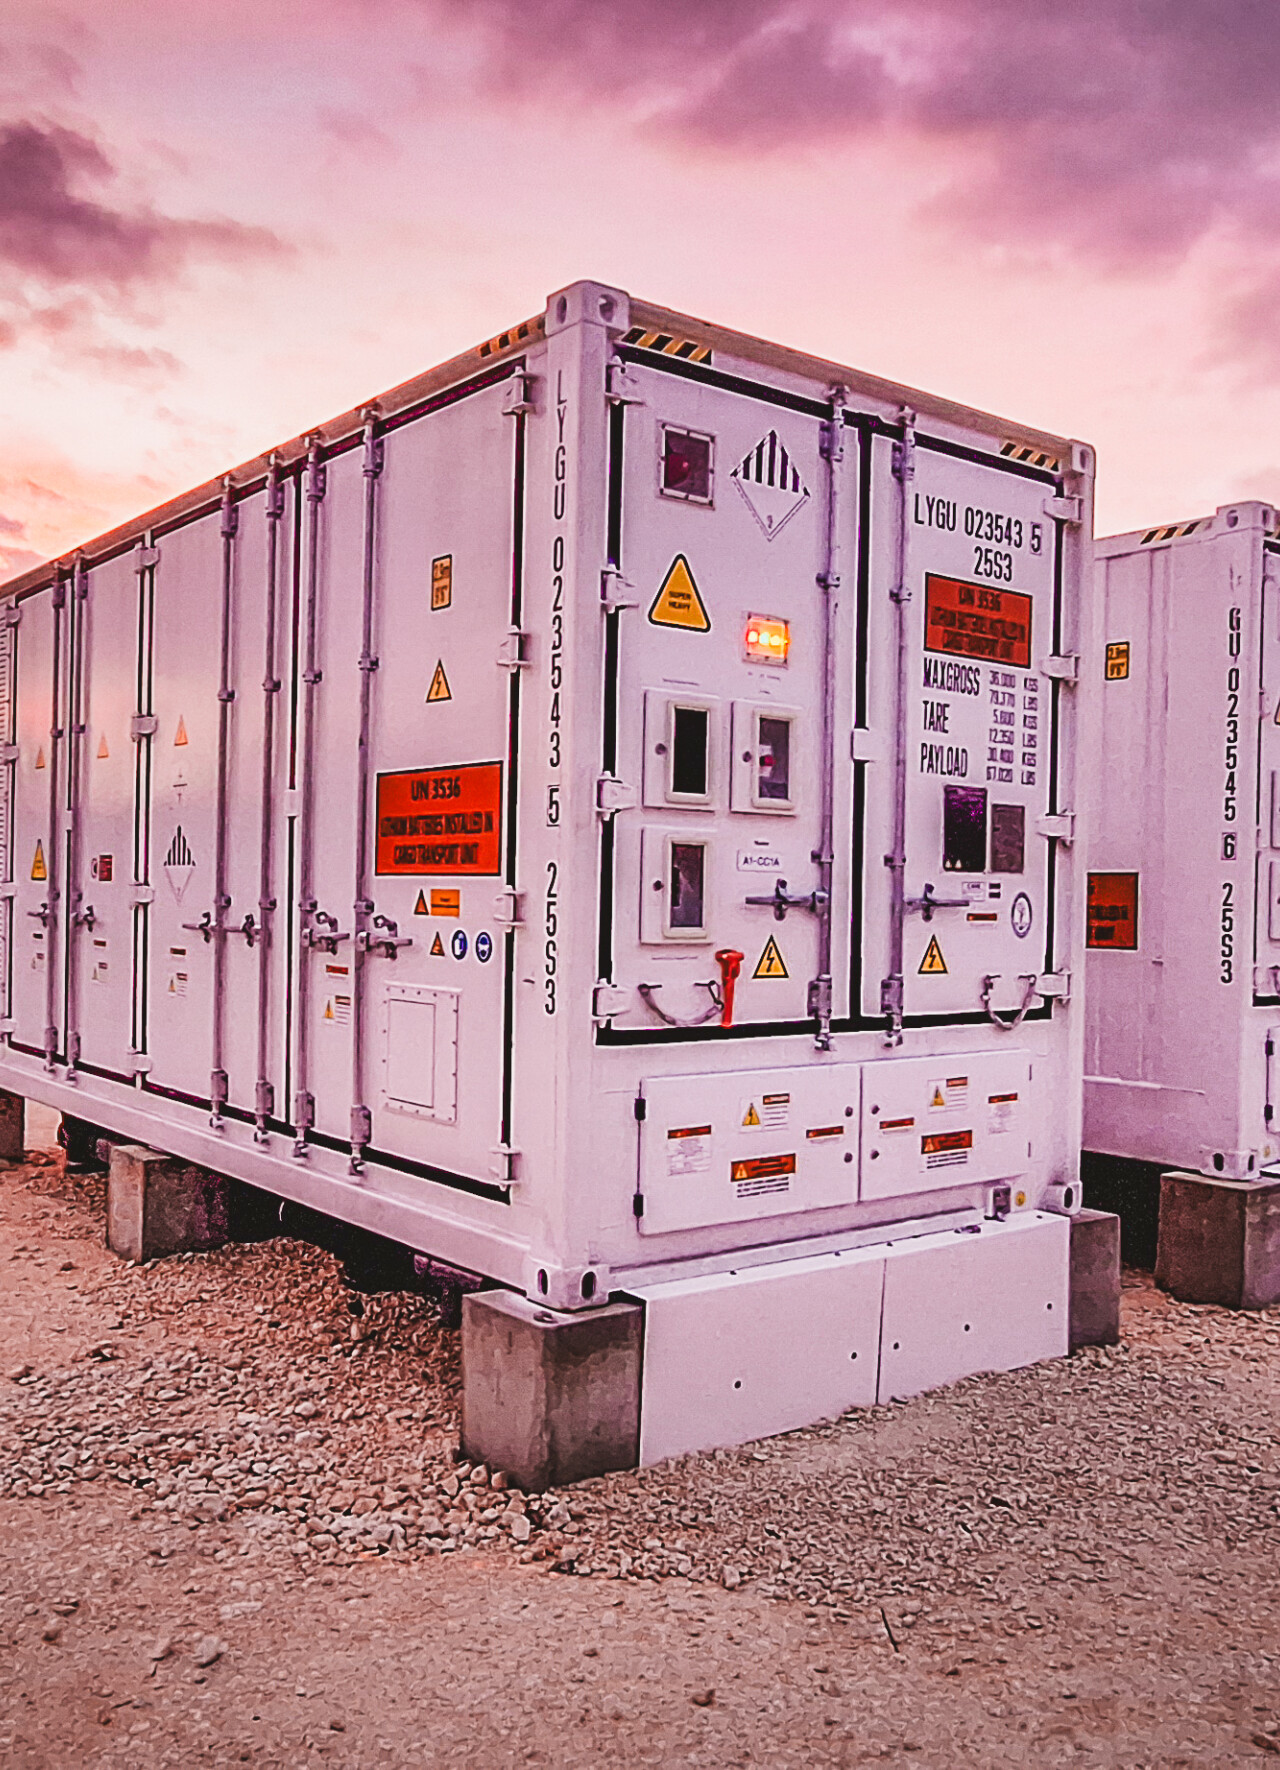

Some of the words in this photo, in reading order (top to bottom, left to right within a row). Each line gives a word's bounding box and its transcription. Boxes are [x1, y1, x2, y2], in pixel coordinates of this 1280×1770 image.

[554, 370, 567, 520] LYGU
[913, 492, 957, 532] LYGU
[964, 506, 1023, 549] 023543
[1030, 523, 1042, 553] 5
[973, 545, 1013, 582] 25S3
[549, 536, 564, 767] 023543
[923, 657, 981, 697] MAXGROSS
[922, 700, 951, 735] TARE
[919, 742, 969, 778] PAYLOAD
[1224, 667, 1241, 821] 023545
[411, 779, 429, 802] UN
[431, 776, 462, 800] 3536
[548, 787, 560, 824] 5
[1223, 834, 1236, 859] 6
[545, 862, 557, 1015] 25S3
[1220, 882, 1234, 984] 25S3
